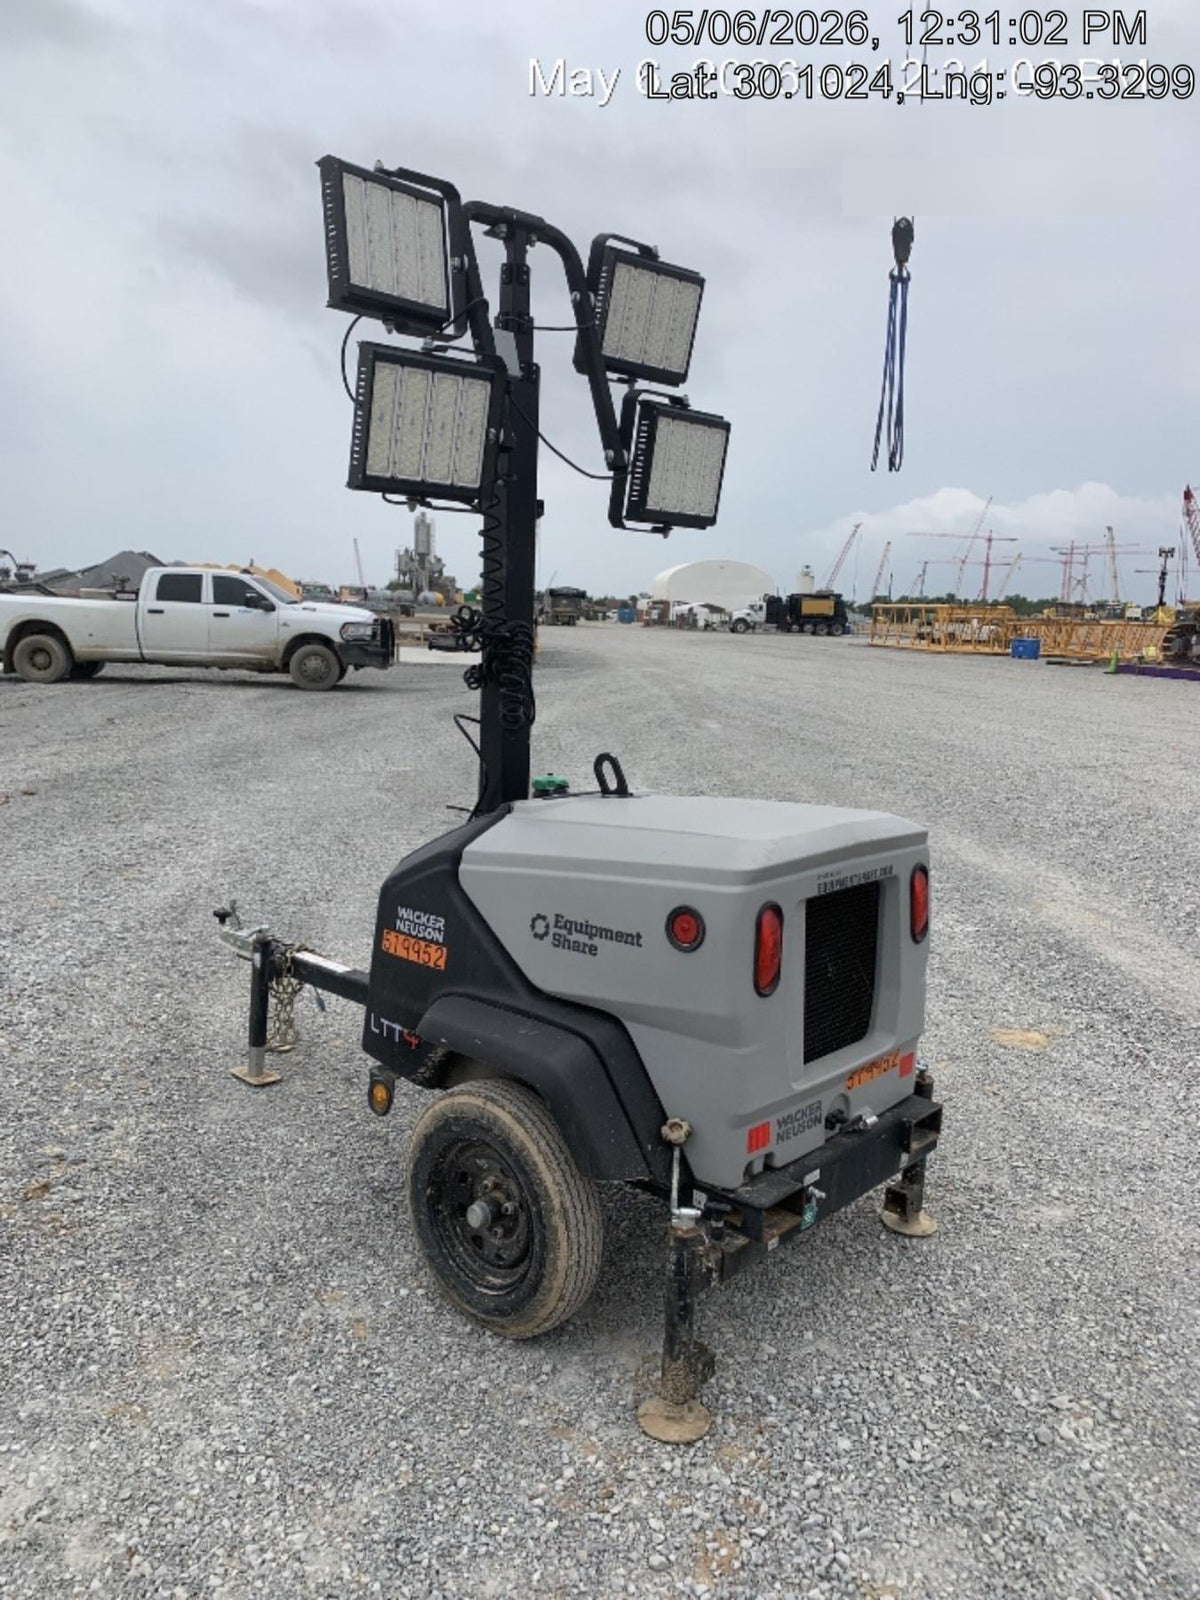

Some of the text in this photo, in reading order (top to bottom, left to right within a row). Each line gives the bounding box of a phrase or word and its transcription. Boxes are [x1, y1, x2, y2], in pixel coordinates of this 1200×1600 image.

[395, 918, 444, 944] NEUSON
[397, 905, 445, 931] WACKER
[553, 913, 642, 948] Equipment
[551, 931, 598, 957] Share
[371, 1012, 419, 1050] LTT4
[776, 1100, 822, 1130] WACKER
[776, 1113, 822, 1145] NEUSON
